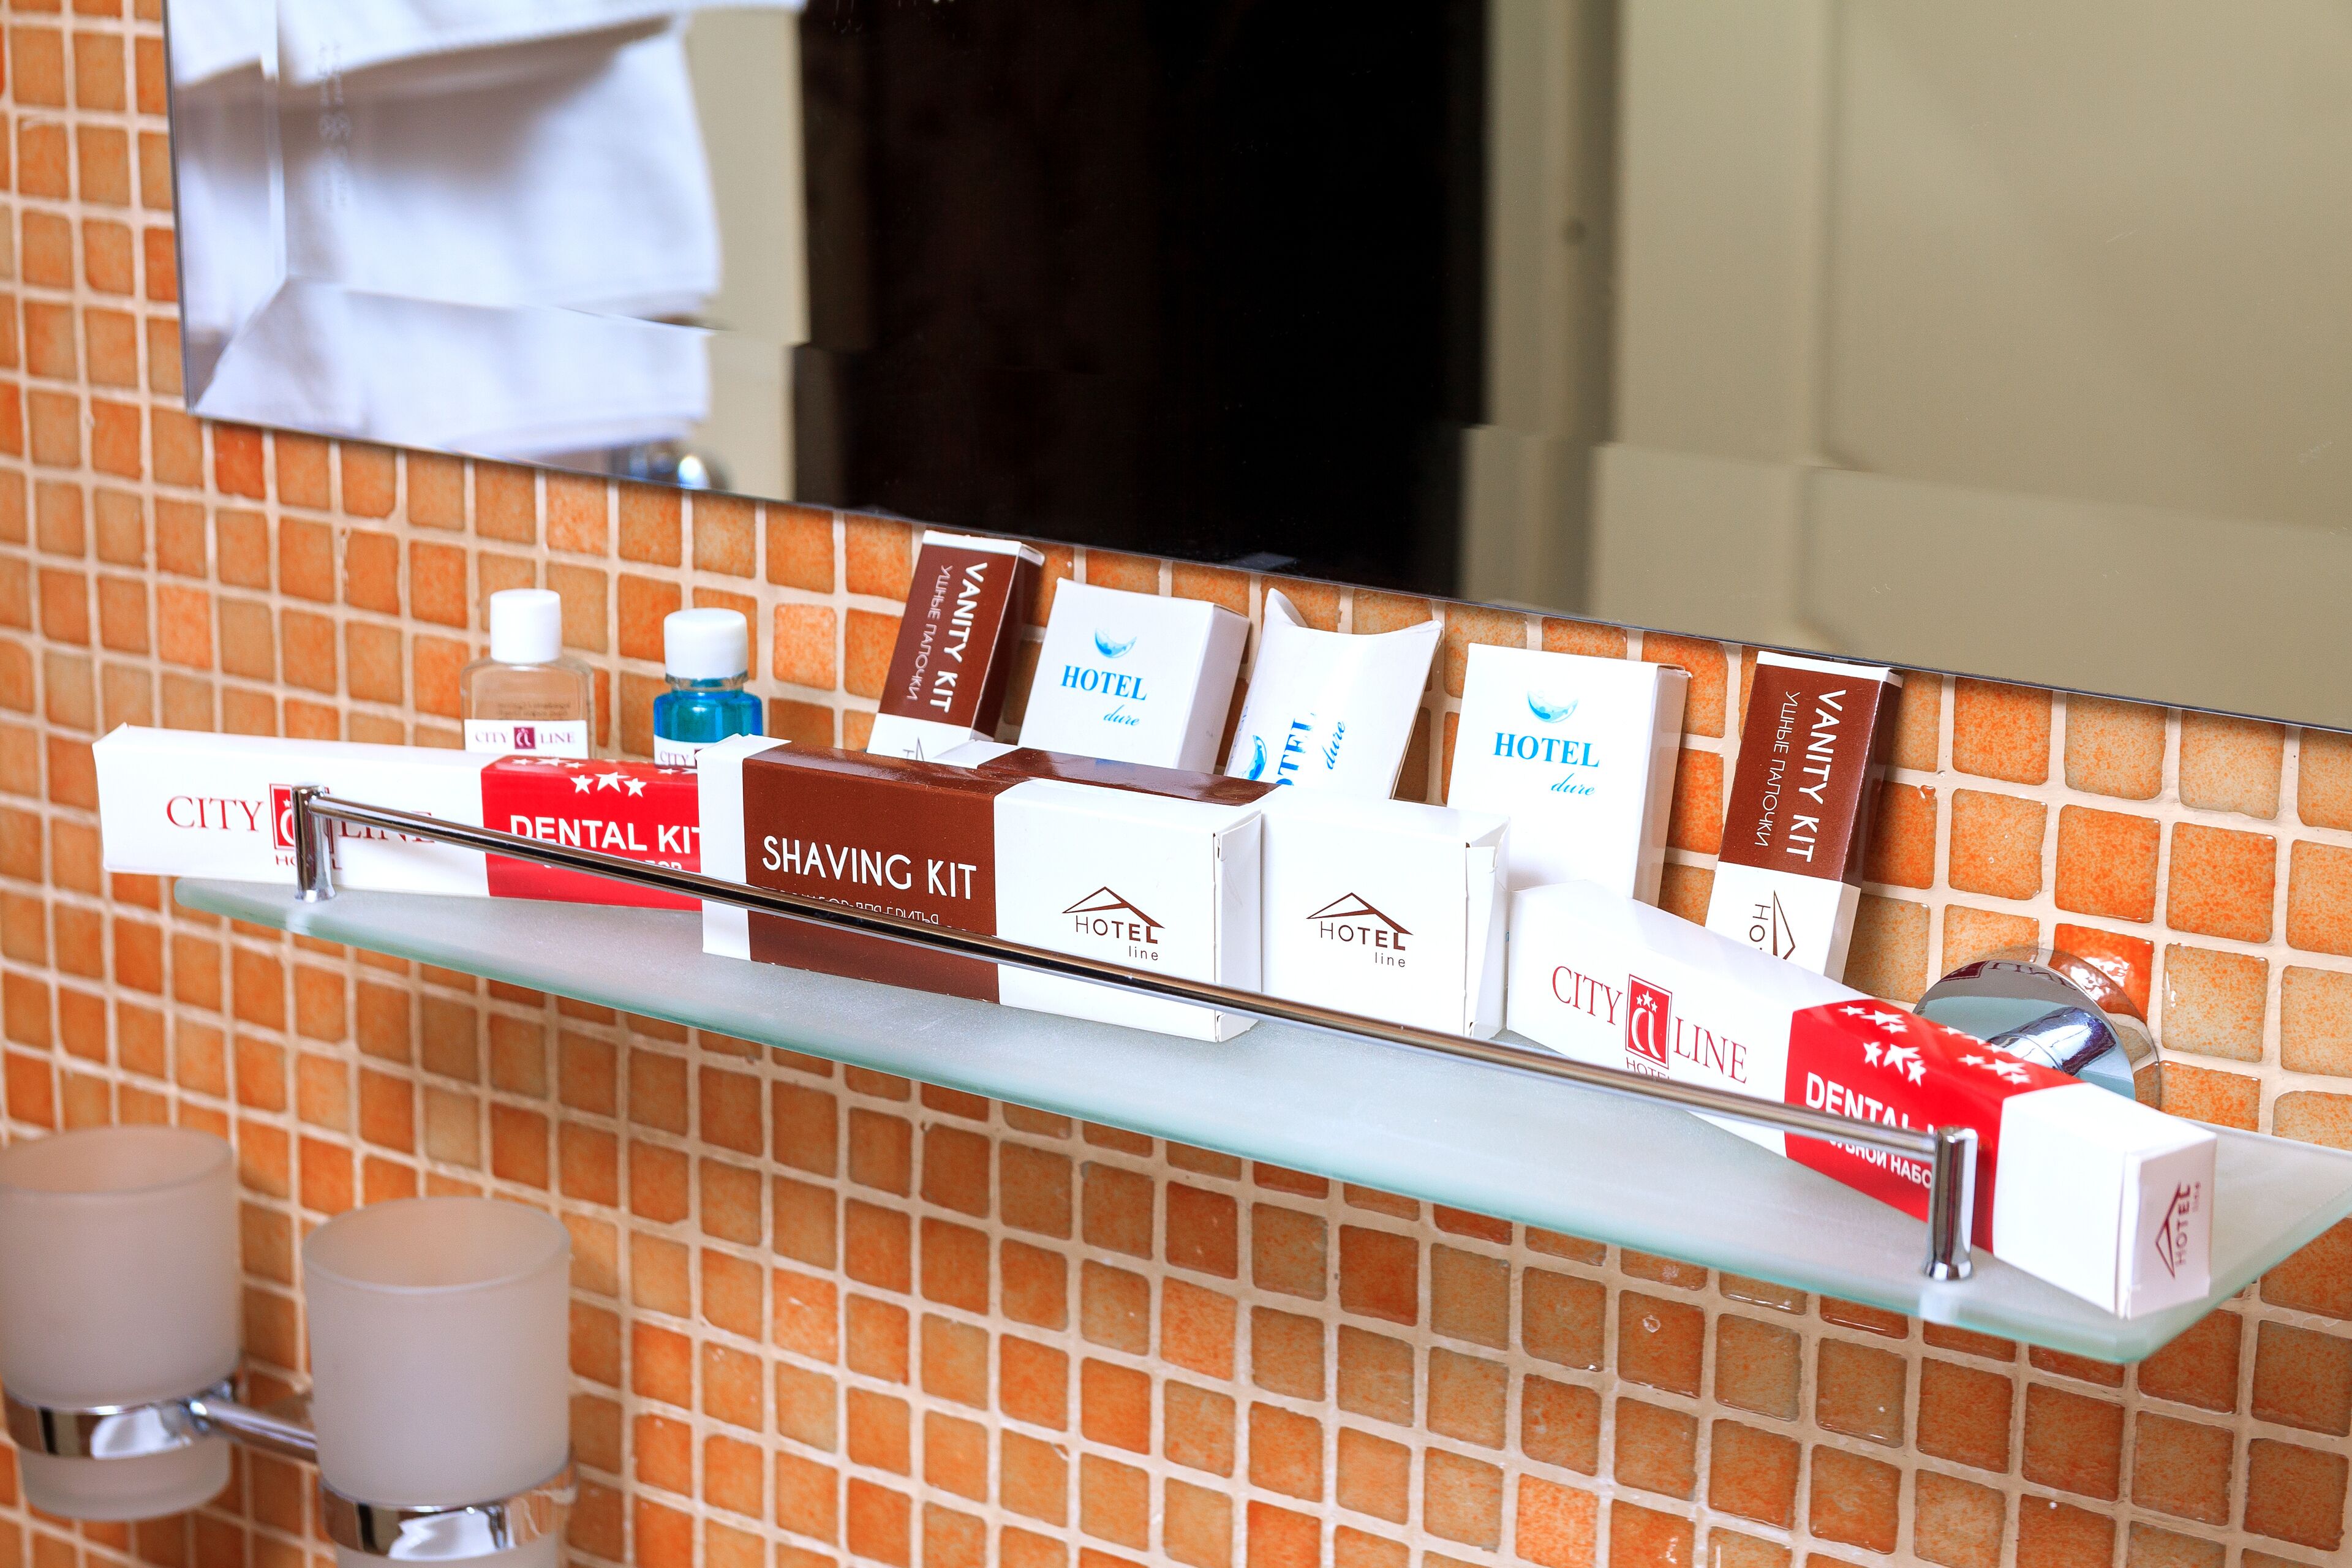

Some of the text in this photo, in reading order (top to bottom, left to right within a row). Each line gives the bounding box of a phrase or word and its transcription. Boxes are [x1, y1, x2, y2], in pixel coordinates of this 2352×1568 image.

[907, 565, 953, 701] УШНЫЕ ПАЛОЧКИ
[930, 562, 987, 713] VANITY KIT
[1060, 665, 1147, 701] HOTEL
[1103, 704, 1140, 726] dure
[475, 731, 575, 744] CITY LINE
[1322, 721, 1346, 769] dure
[1492, 732, 1600, 767] HOTEL
[660, 751, 688, 766] CITY
[1754, 691, 1801, 846] УШНЫЕ ПАЛОЧКИ
[1786, 689, 1847, 862] VANITY KIT
[1551, 772, 1595, 796] dure
[166, 796, 264, 831] CITY
[510, 815, 647, 851] DENTAL
[762, 835, 977, 900] SHAVING KIT
[1075, 915, 1159, 944] HOTEL
[1320, 921, 1406, 951] HOTEL
[1128, 945, 1159, 961] line
[1375, 952, 1406, 968] line
[1552, 965, 1747, 1084] CITY LINE
[2174, 1184, 2191, 1266] HOTEL
